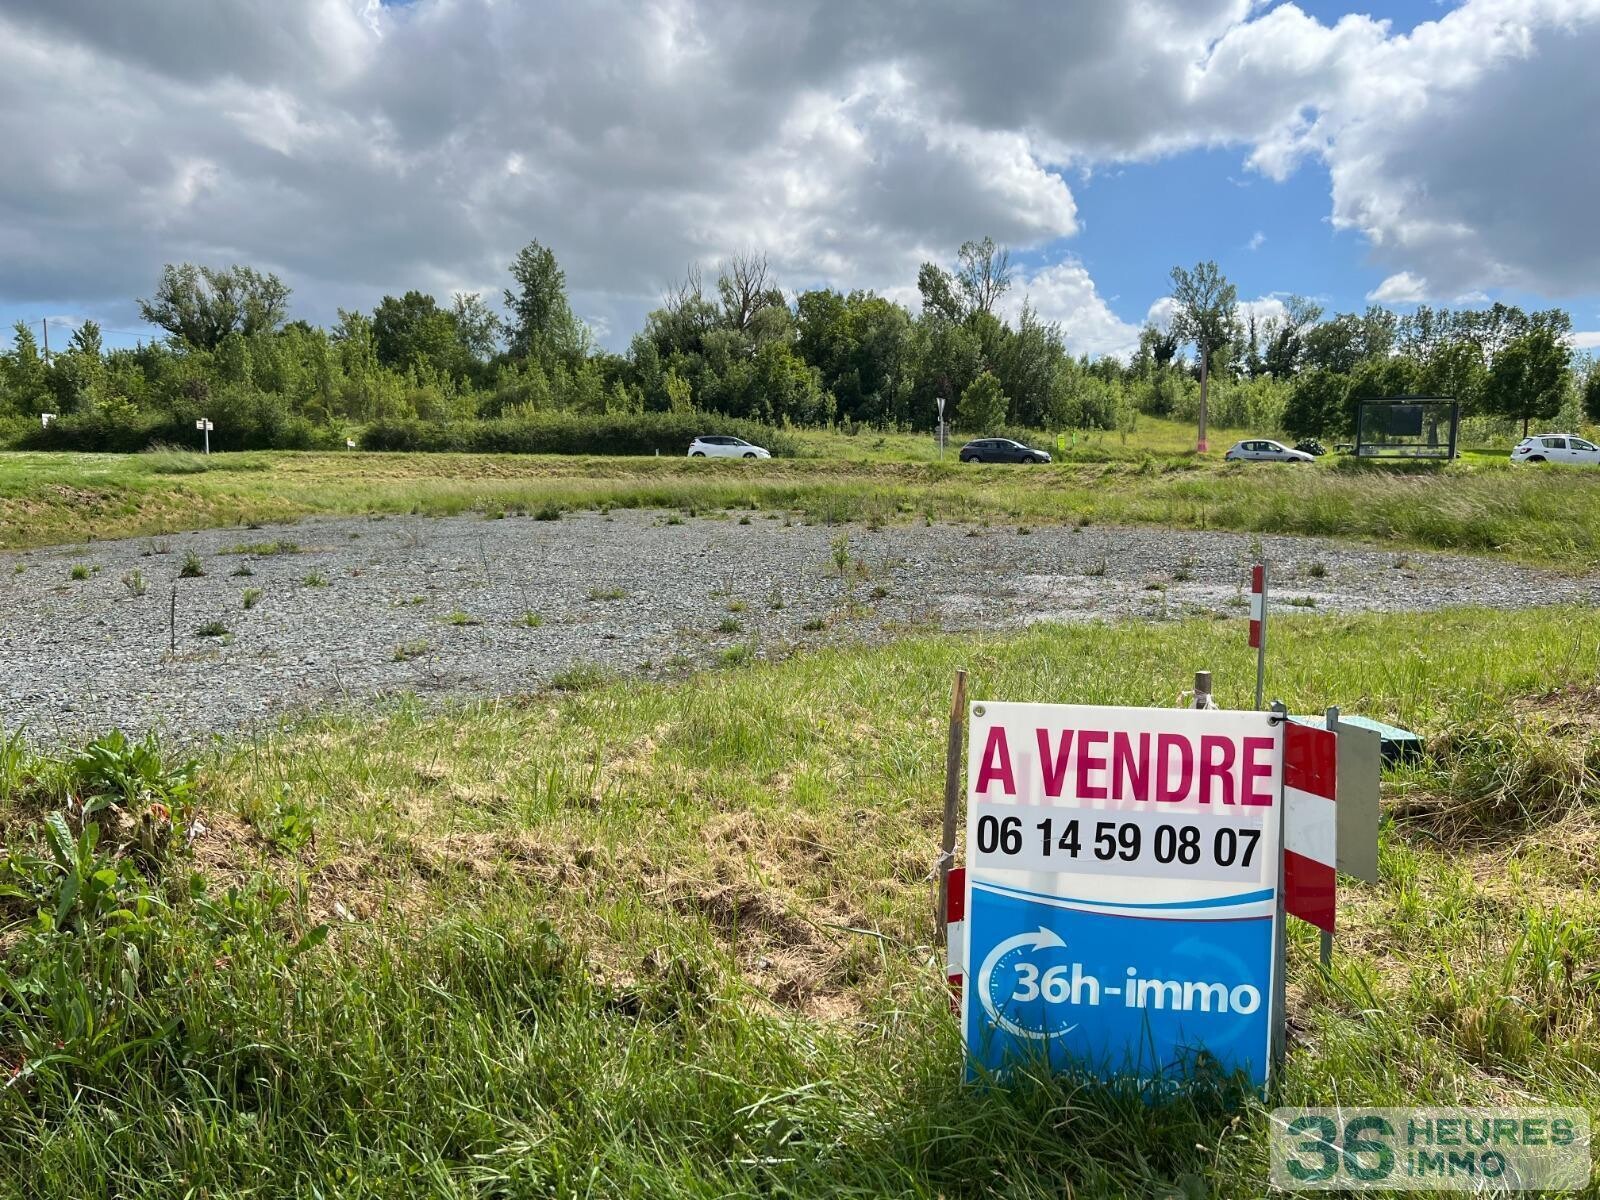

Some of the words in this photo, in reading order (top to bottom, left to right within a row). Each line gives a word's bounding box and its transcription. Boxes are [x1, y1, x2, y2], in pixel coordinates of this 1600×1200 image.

[975, 726, 1016, 795] A
[1036, 728, 1275, 806] VENDRE
[977, 815, 1023, 855] 06
[1036, 818, 1082, 858] 14
[1094, 822, 1142, 862] 59
[1153, 824, 1201, 865] 08
[1213, 827, 1262, 868] 07
[1012, 963, 1261, 1015] 36h-immo
